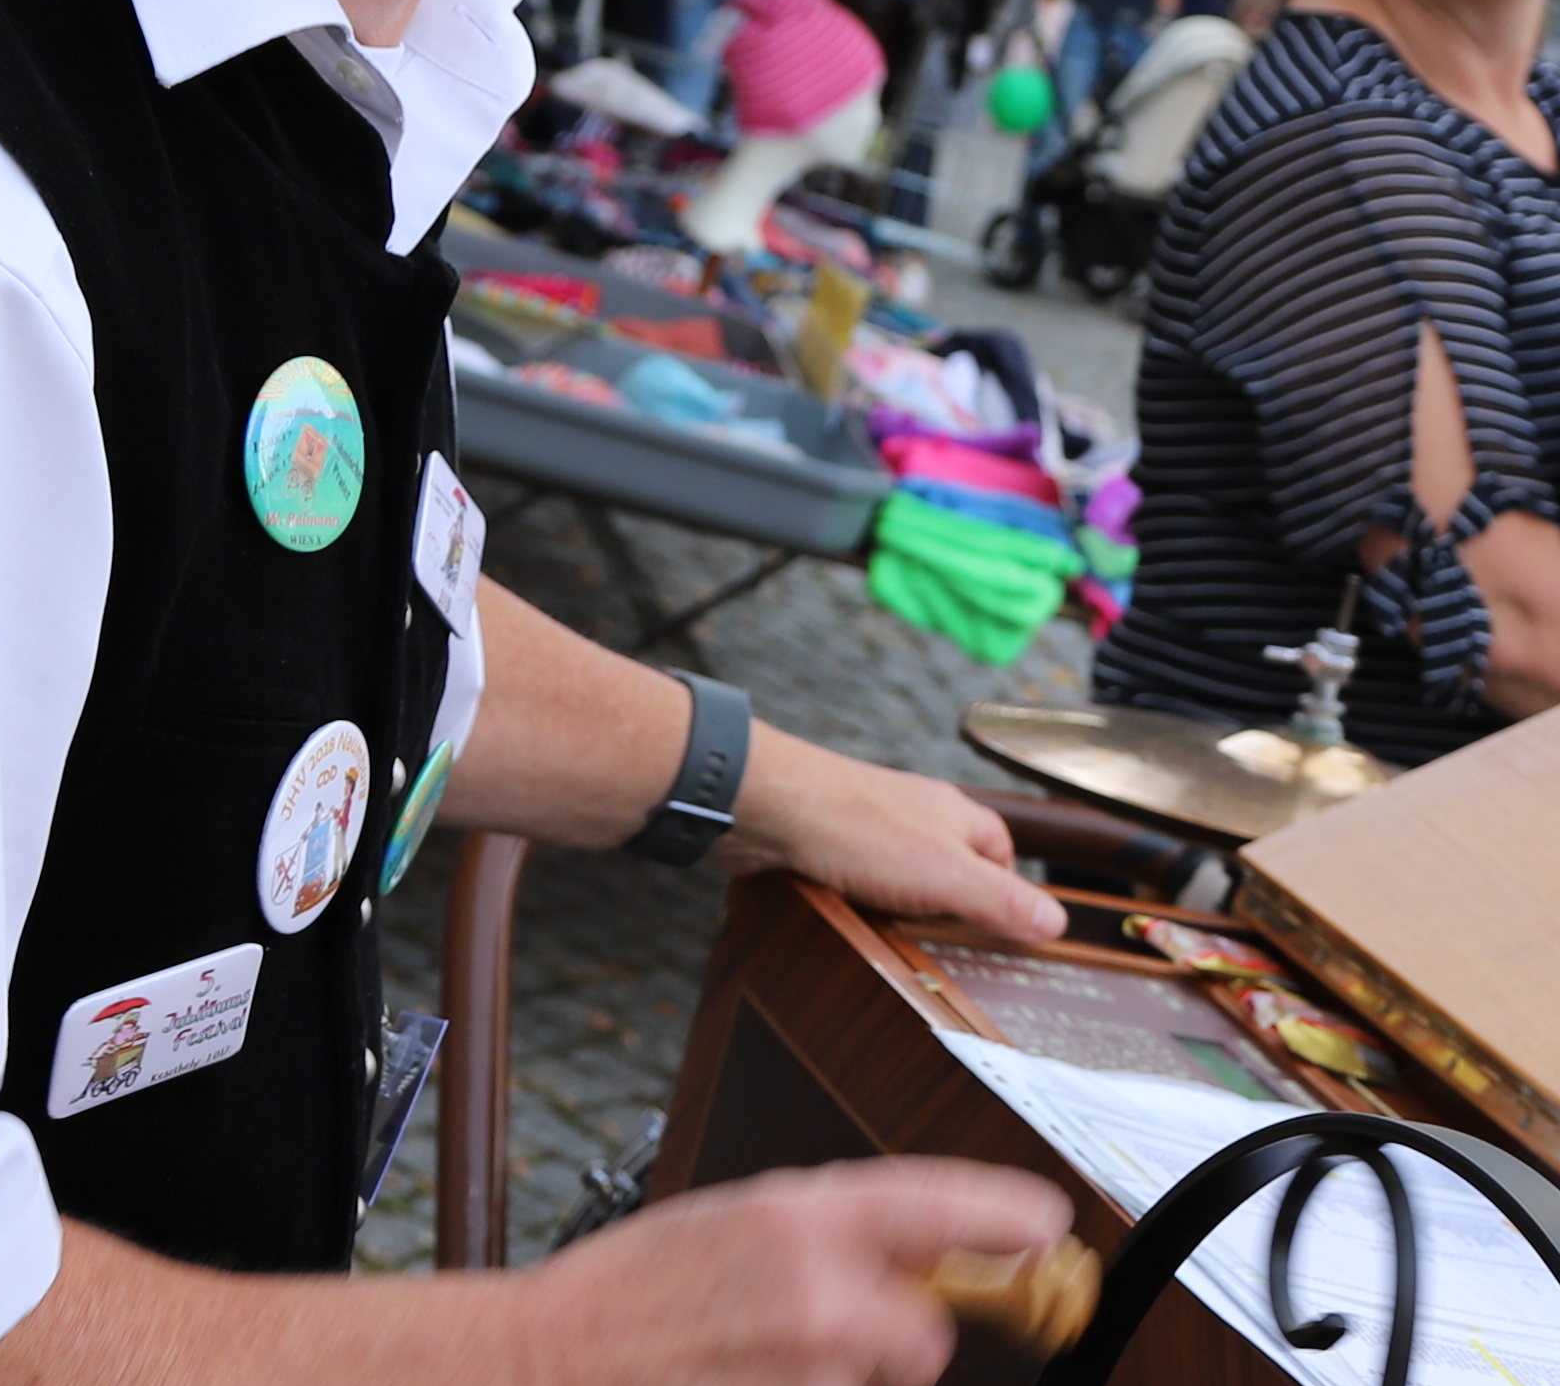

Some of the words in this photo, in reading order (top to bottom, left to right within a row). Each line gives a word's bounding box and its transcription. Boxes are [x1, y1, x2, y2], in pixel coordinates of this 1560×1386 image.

[280, 766, 308, 821] JHV
[308, 737, 336, 771] 2018
[198, 968, 221, 999] 5.
